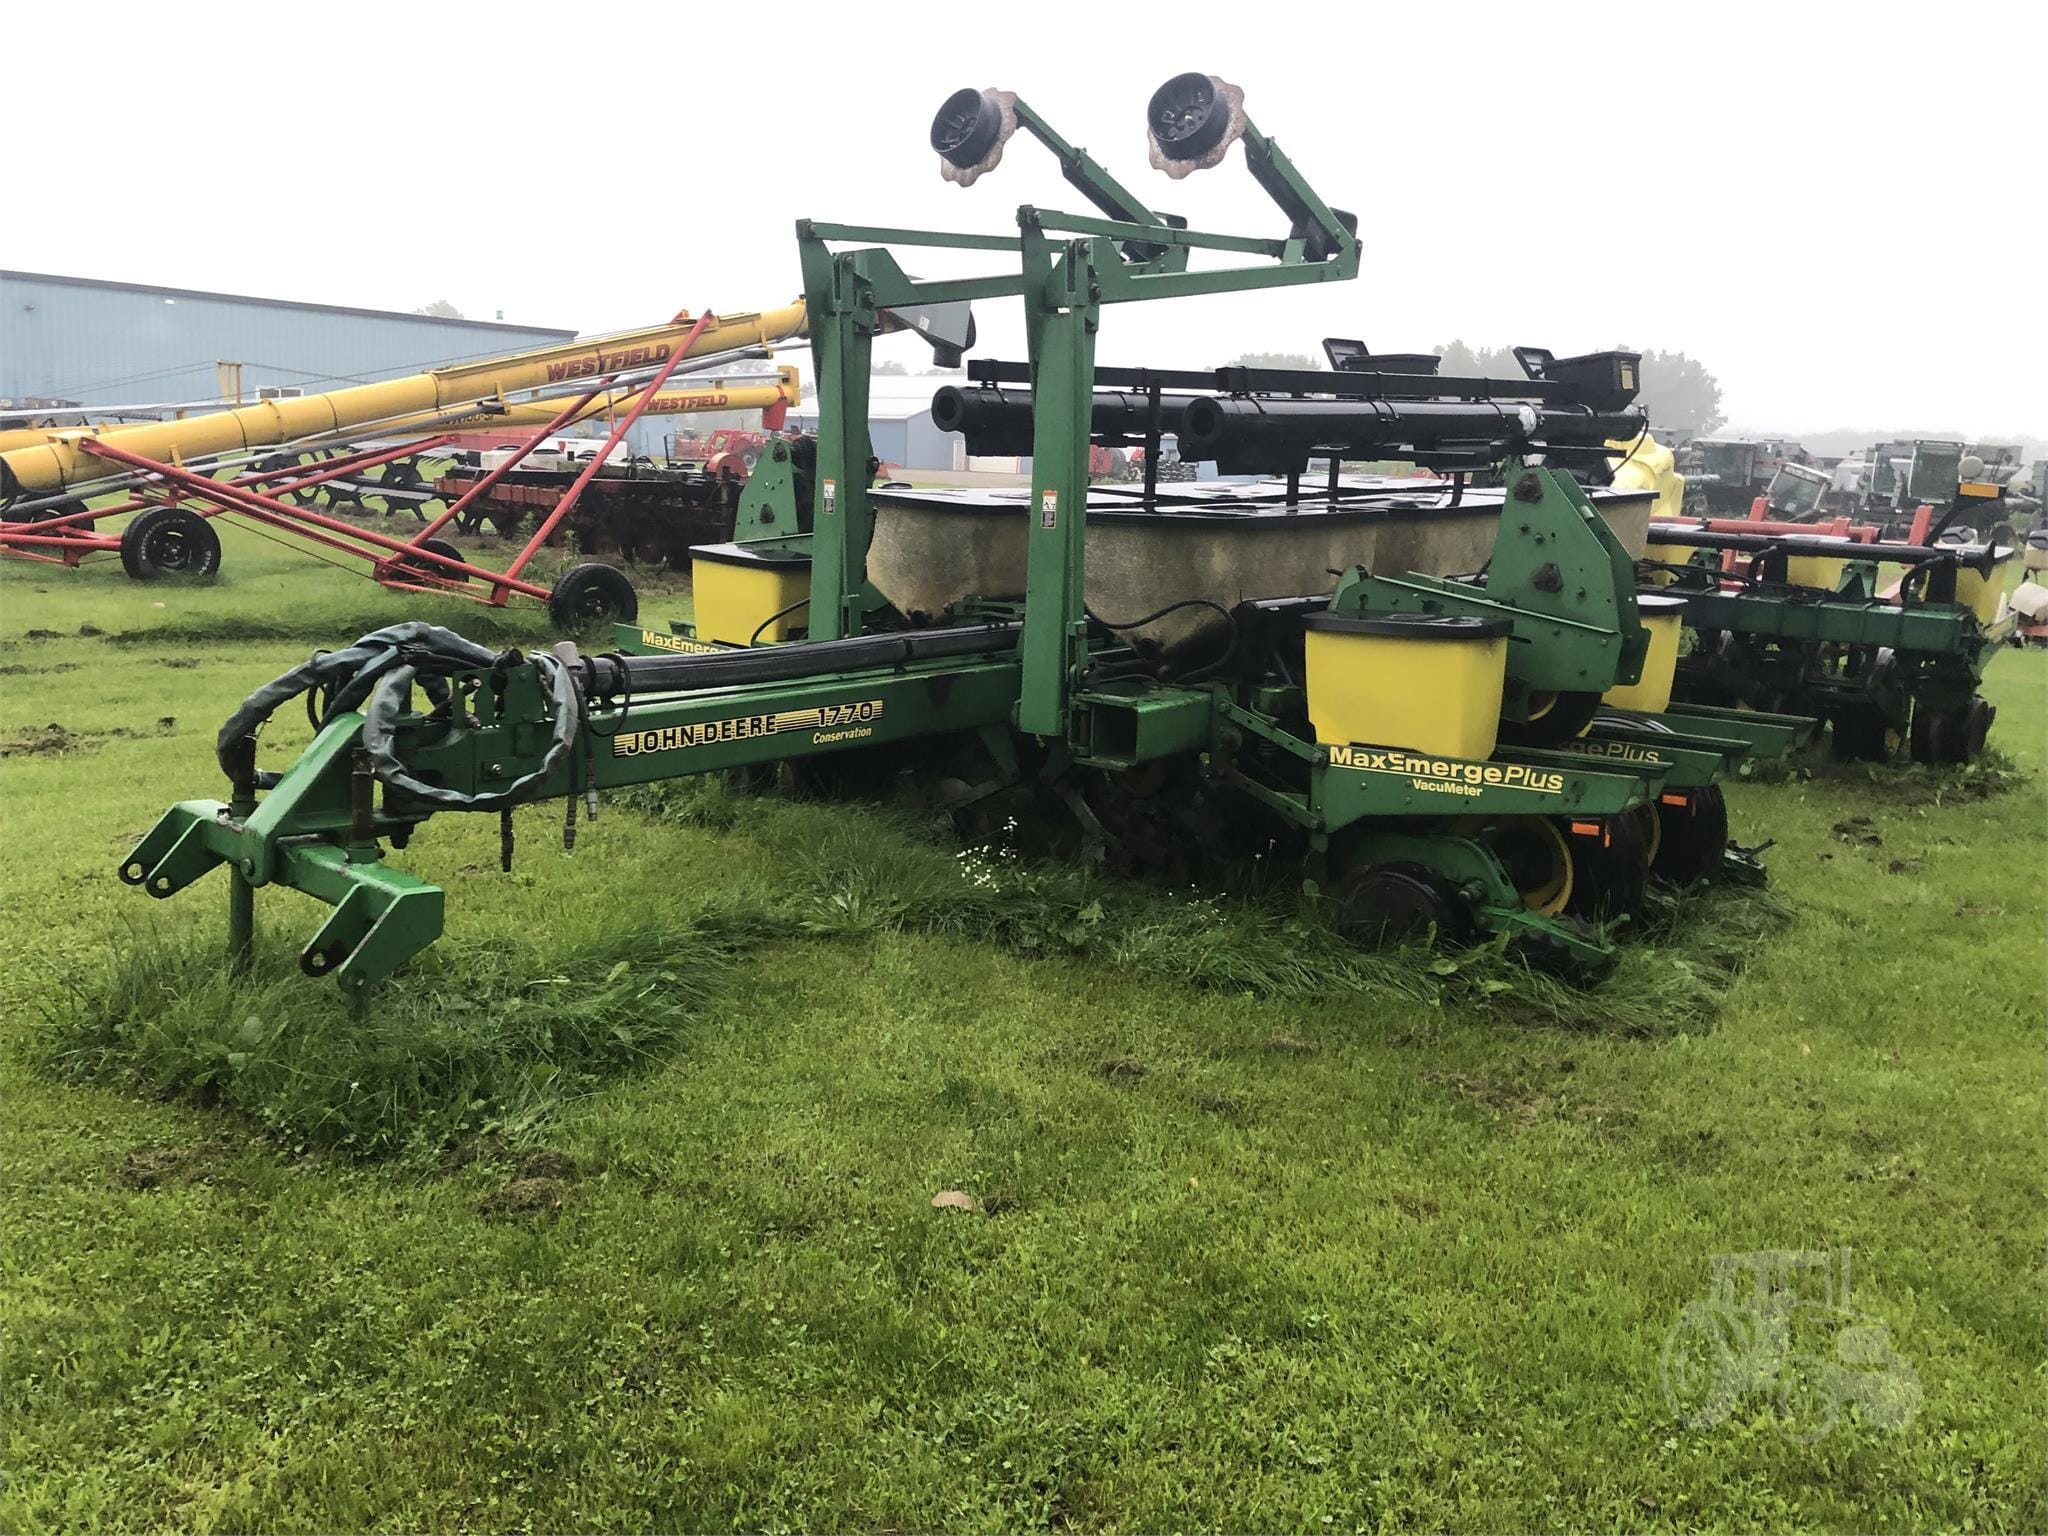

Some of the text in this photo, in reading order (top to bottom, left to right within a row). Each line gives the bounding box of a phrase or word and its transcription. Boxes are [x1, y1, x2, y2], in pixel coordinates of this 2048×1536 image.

[546, 344, 670, 382] WESTFIELD
[647, 394, 728, 411] WESTFIELD
[626, 702, 873, 755] JOHN DEERE 1770
[813, 727, 872, 744] Conservation
[1412, 779, 1483, 797] VacuMeter
